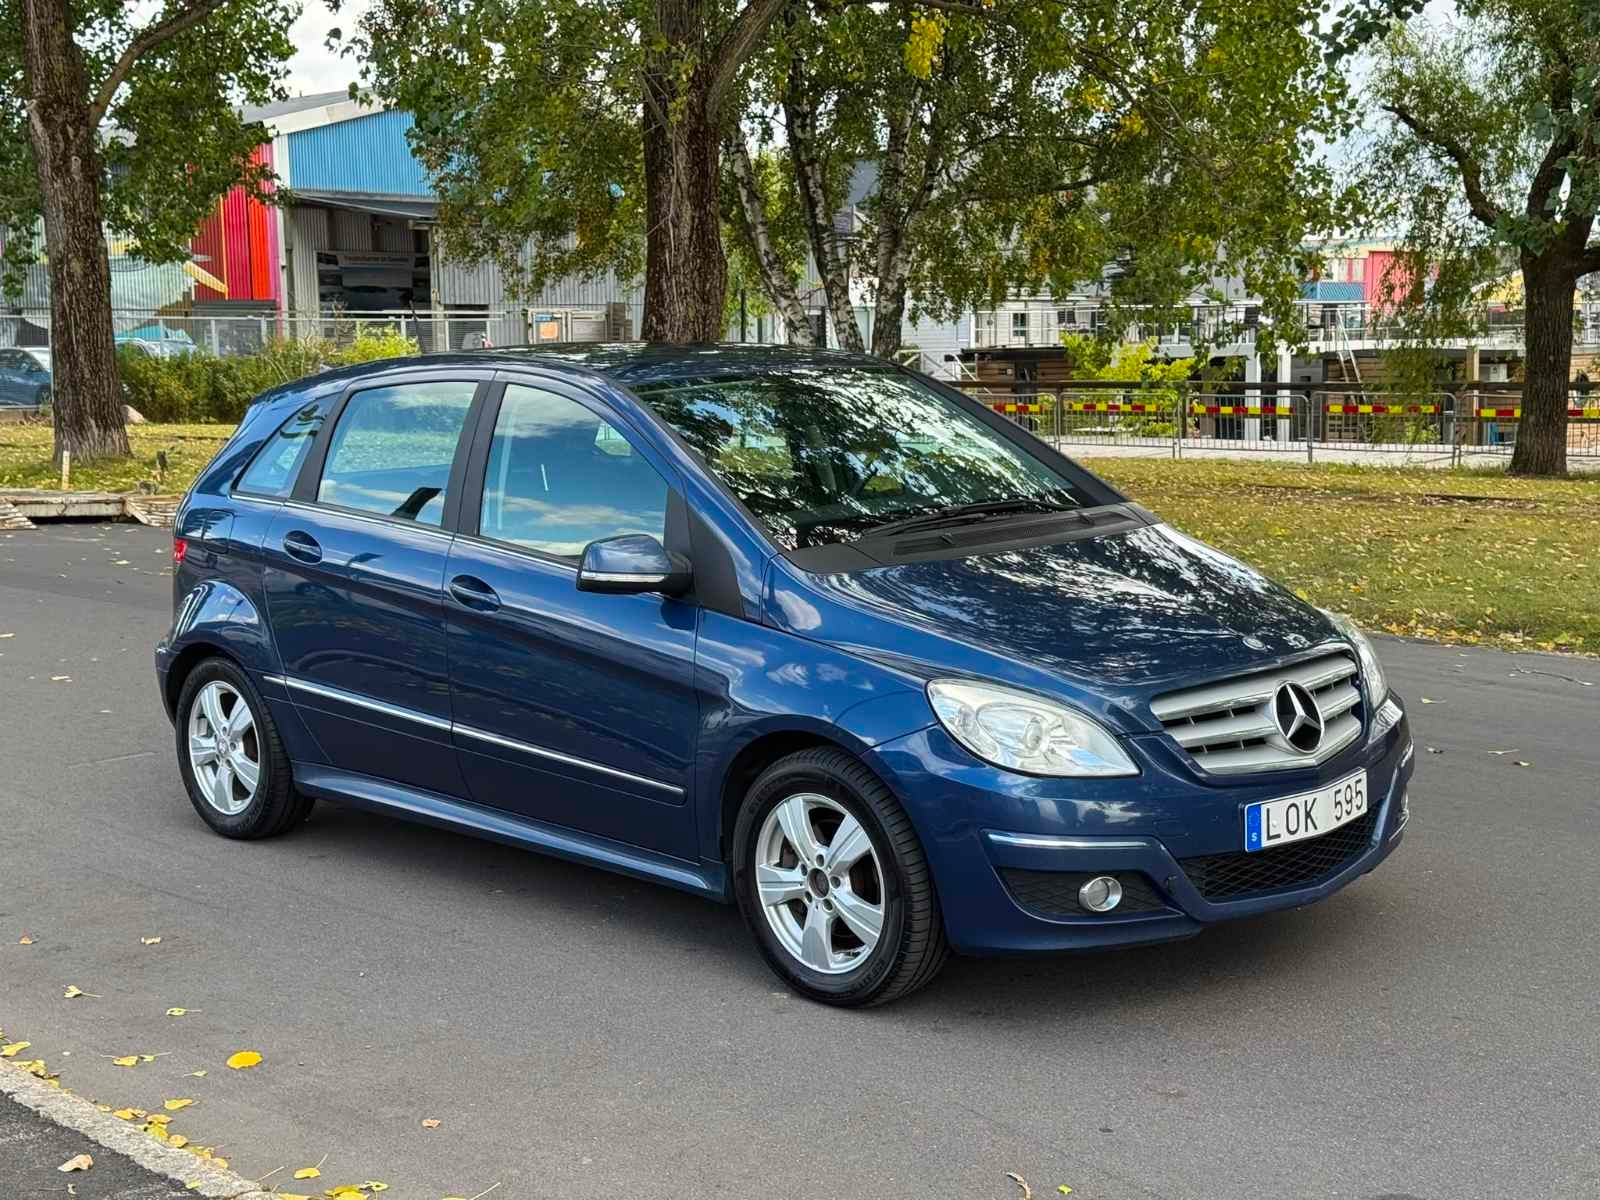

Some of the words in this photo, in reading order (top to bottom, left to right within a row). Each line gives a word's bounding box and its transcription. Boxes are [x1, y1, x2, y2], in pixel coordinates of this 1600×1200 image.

[1266, 798, 1318, 841] LOK
[1334, 778, 1364, 822] 595
[1251, 832, 1258, 842] S
